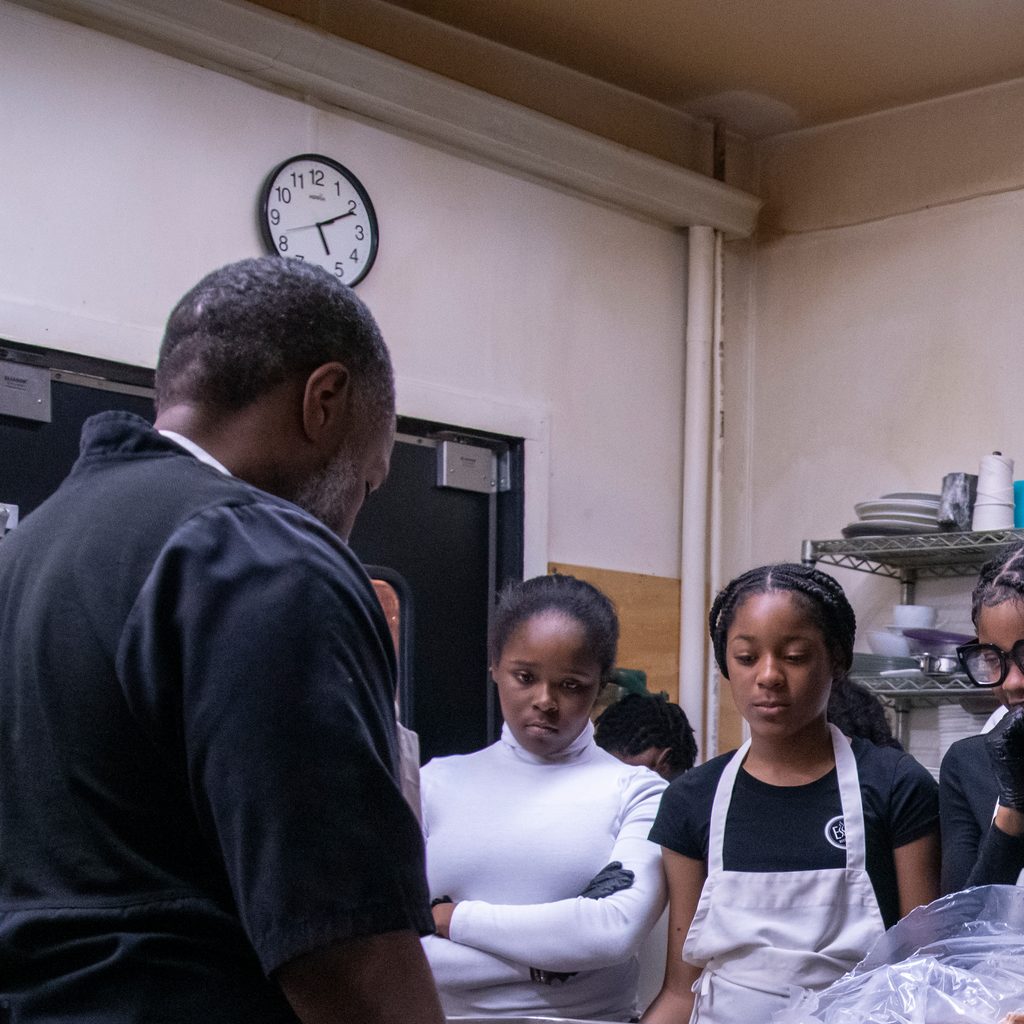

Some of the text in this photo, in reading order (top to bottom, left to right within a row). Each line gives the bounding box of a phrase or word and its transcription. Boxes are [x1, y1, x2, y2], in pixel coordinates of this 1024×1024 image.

[290, 172, 304, 189] 11
[309, 169, 325, 187] 12
[275, 186, 292, 204] 10
[334, 181, 341, 196] 1
[347, 200, 358, 216] 2
[270, 208, 281, 226] 9
[354, 225, 365, 241] 3
[278, 235, 289, 252] 8
[349, 248, 359, 263] 4
[334, 262, 345, 278] 5
